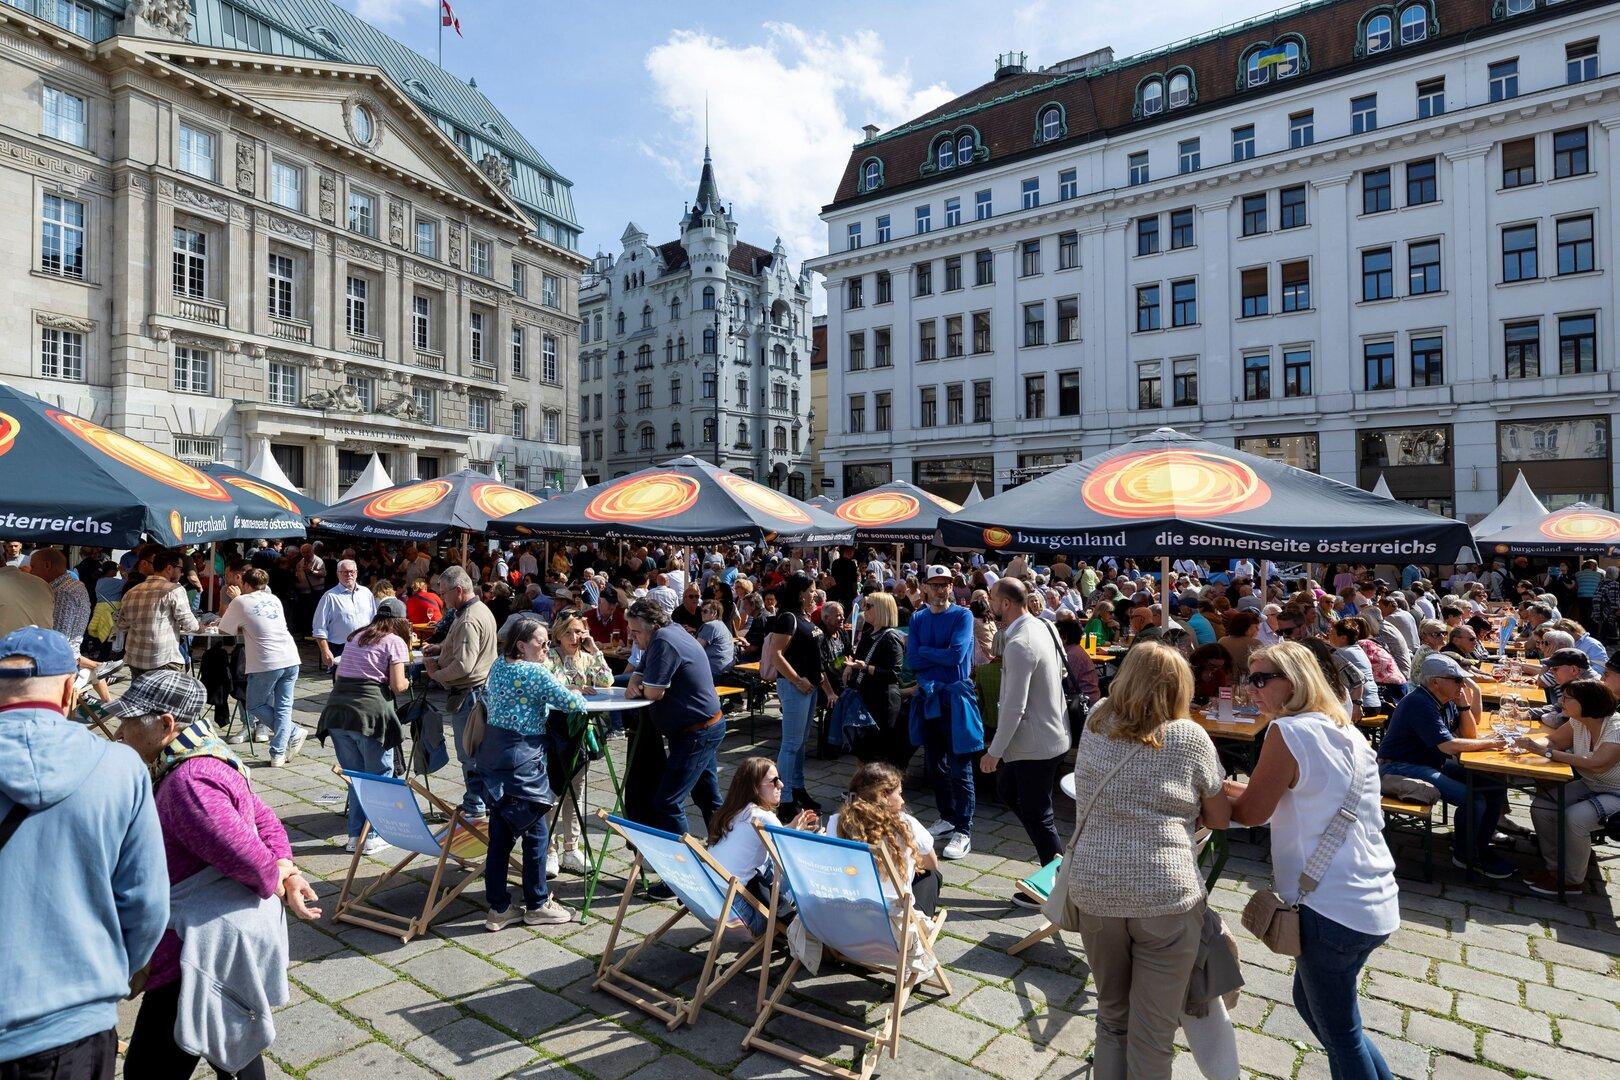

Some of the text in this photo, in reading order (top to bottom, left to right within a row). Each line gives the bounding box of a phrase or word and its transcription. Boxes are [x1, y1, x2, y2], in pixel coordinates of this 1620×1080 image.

[333, 426, 416, 441] PARK HYATT VIENNA
[183, 515, 228, 537] burgenland
[1018, 531, 1437, 555] burgenland die sonnenseite österreichs
[1511, 545, 1561, 553] burgenland
